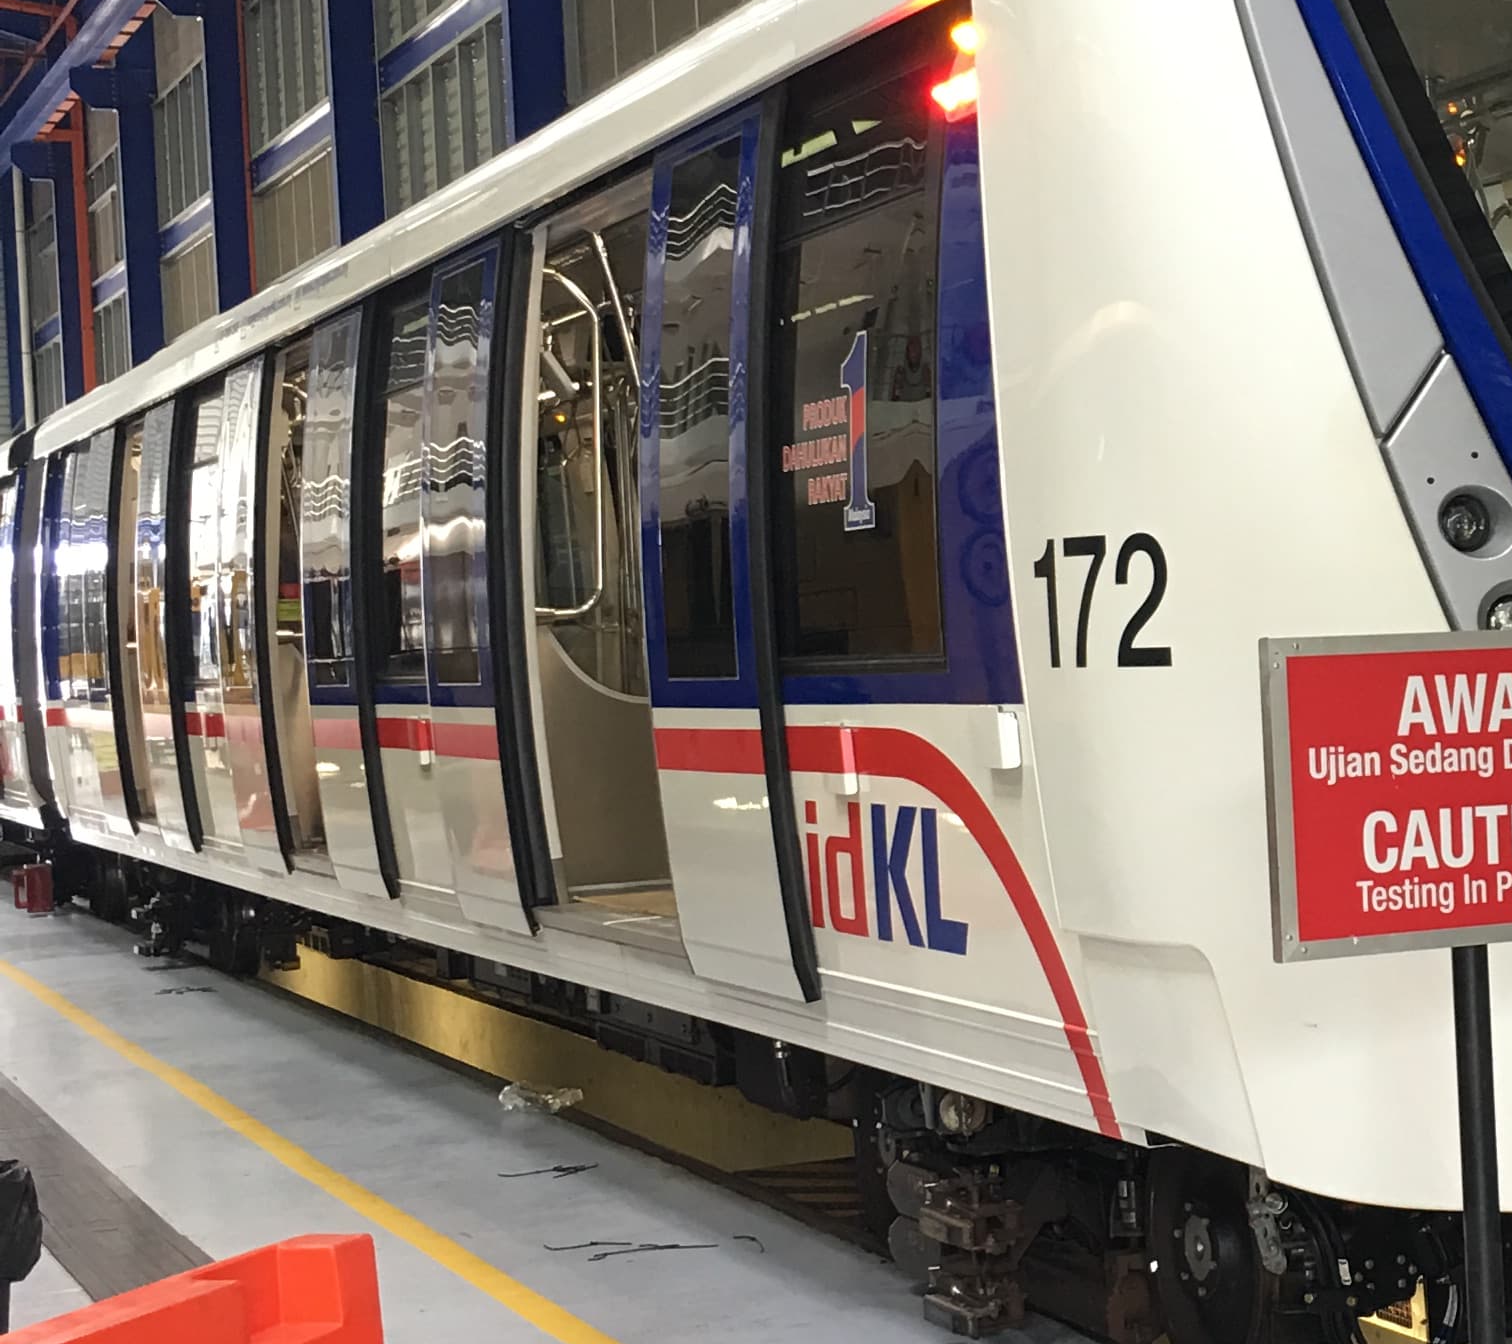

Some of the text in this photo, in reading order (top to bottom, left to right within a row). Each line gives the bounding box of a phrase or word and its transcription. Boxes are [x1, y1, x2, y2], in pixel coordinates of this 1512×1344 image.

[803, 395, 848, 431] PRODUK
[782, 434, 848, 472] DAHULUKAN
[808, 473, 848, 505] RAKYAT
[1033, 532, 1172, 668] 172
[1308, 746, 1381, 785] Ujian
[1390, 742, 1494, 778] Sedang
[1356, 879, 1455, 914] Testing
[1463, 873, 1488, 903] In
